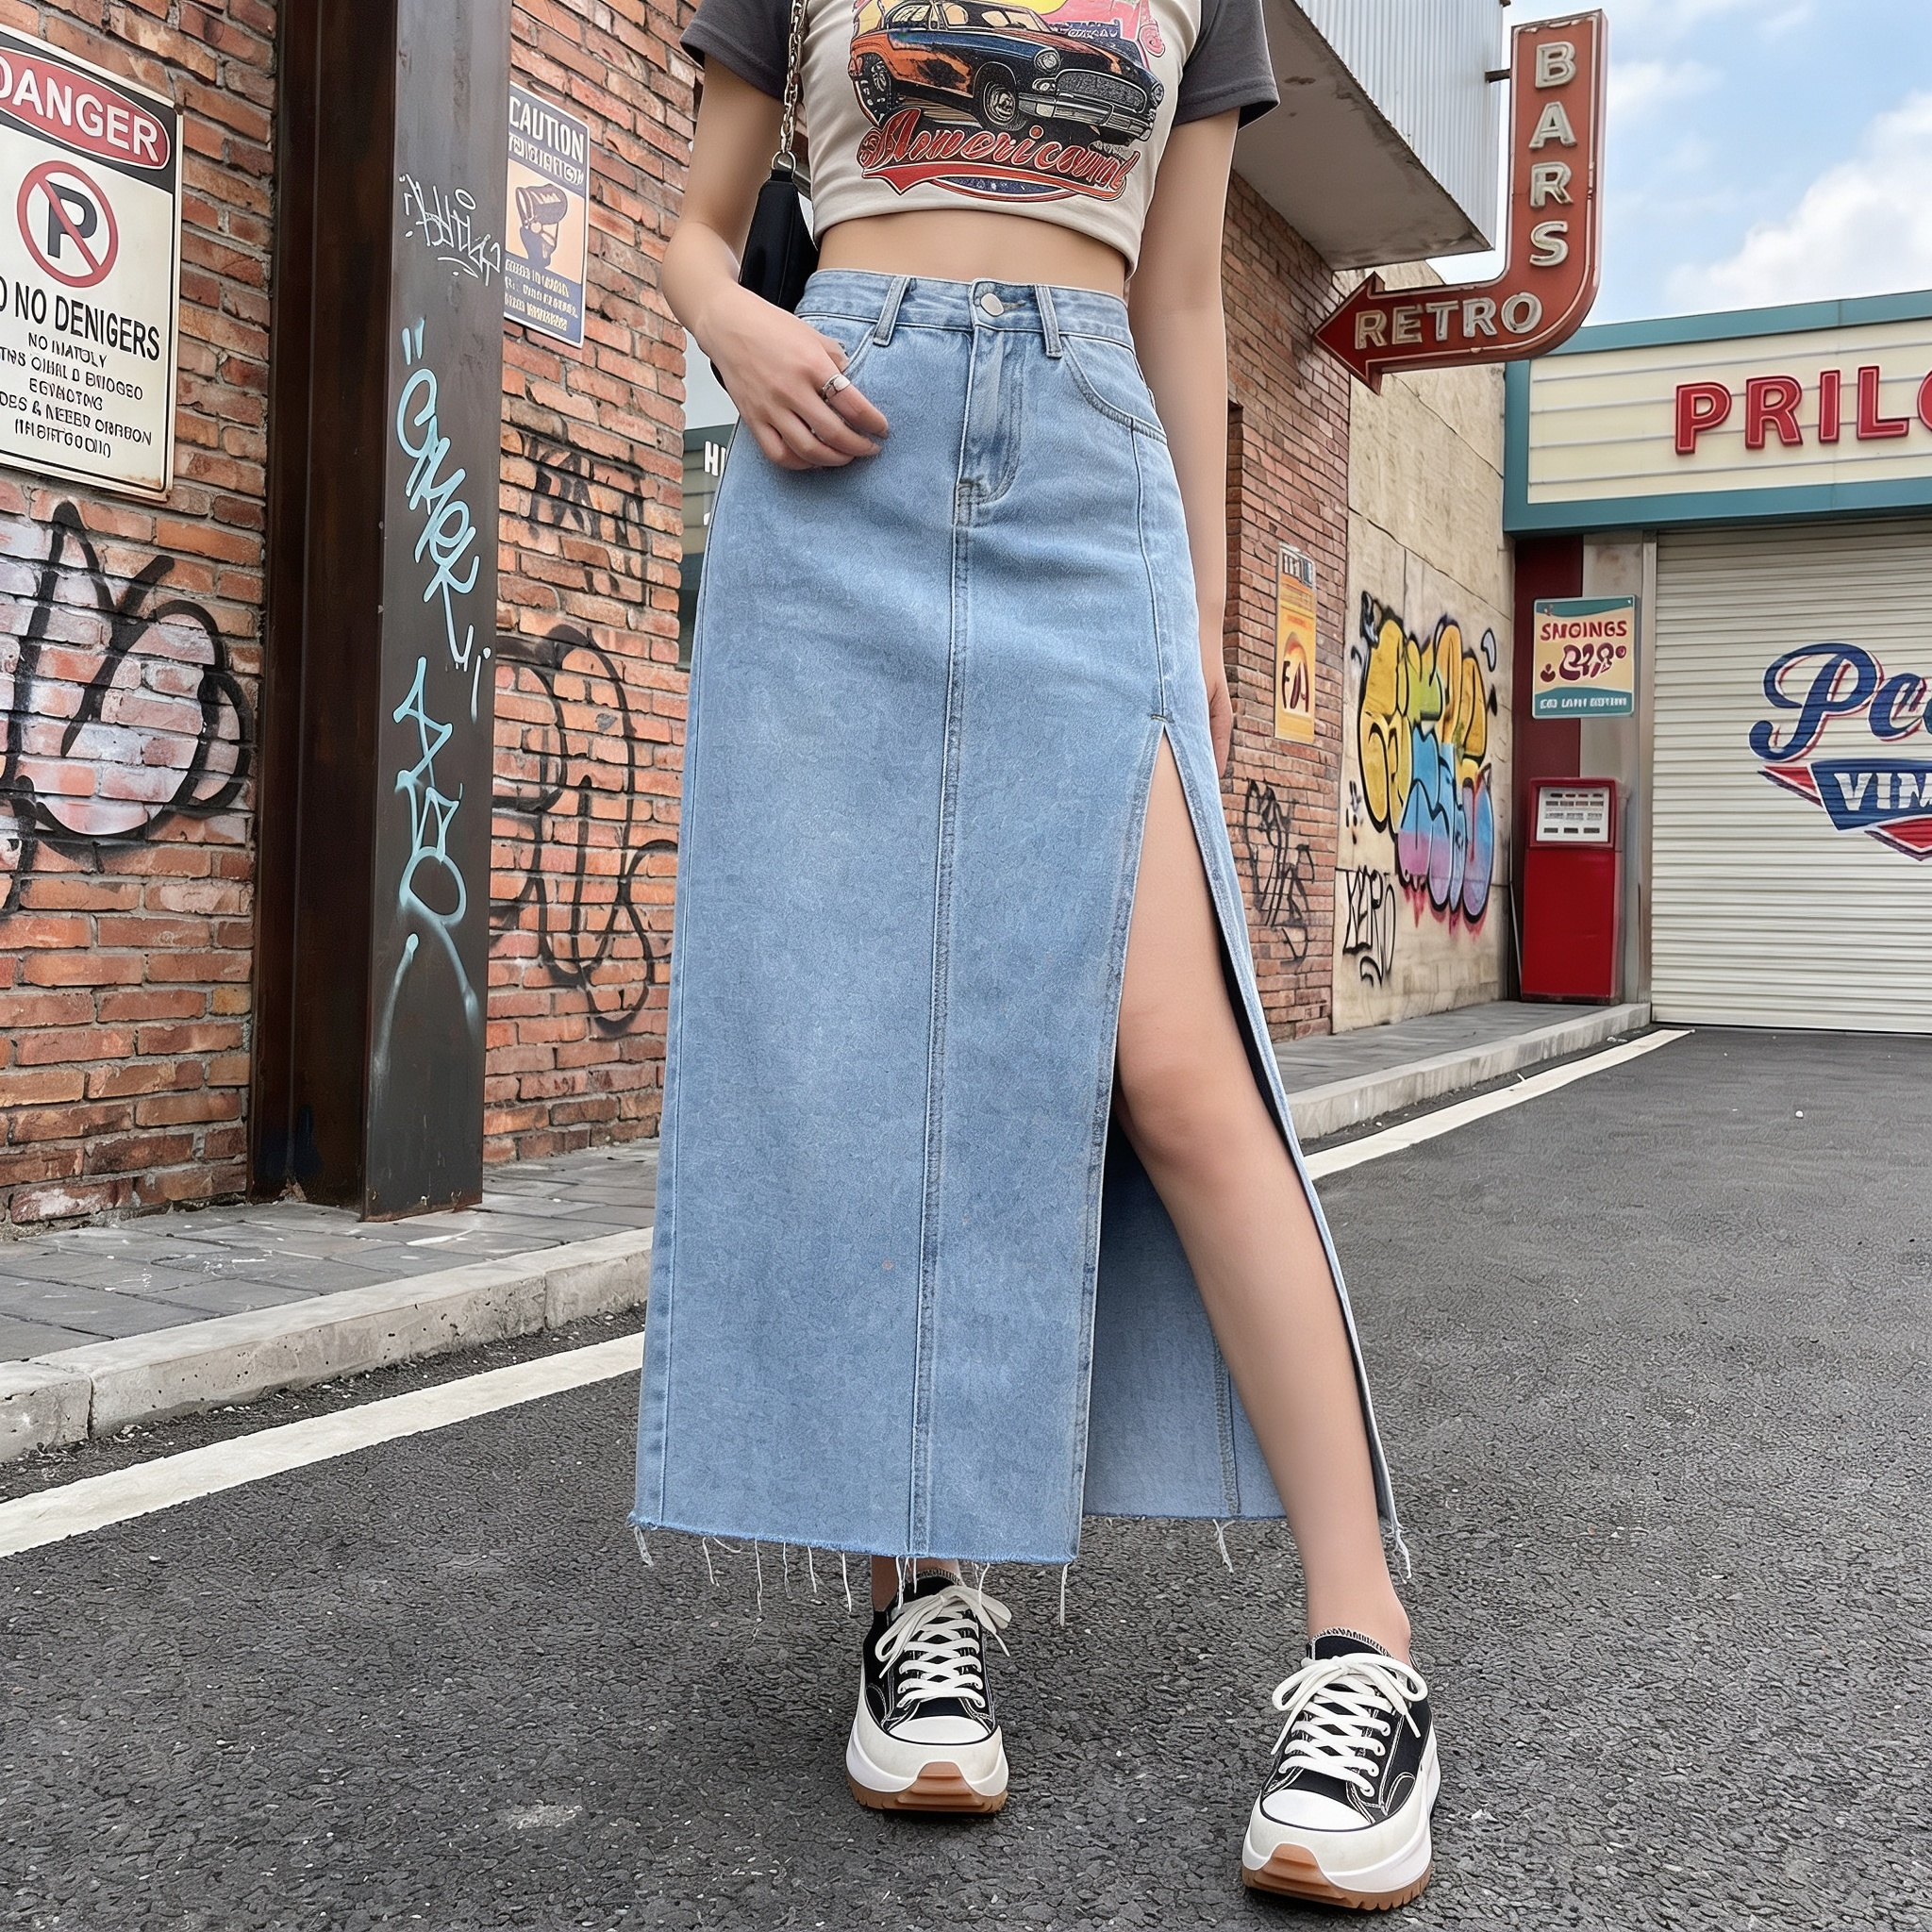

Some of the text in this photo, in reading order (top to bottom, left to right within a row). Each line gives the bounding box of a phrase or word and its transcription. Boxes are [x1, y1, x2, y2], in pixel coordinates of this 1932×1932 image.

[509, 95, 584, 164] CAUTION
[1528, 41, 1577, 267] BARS
[15, 281, 47, 325] NO
[55, 294, 160, 361] DENIGERS
[28, 332, 48, 350] NO
[1354, 291, 1543, 350] RETRO
[1675, 365, 1932, 455] PRIL
